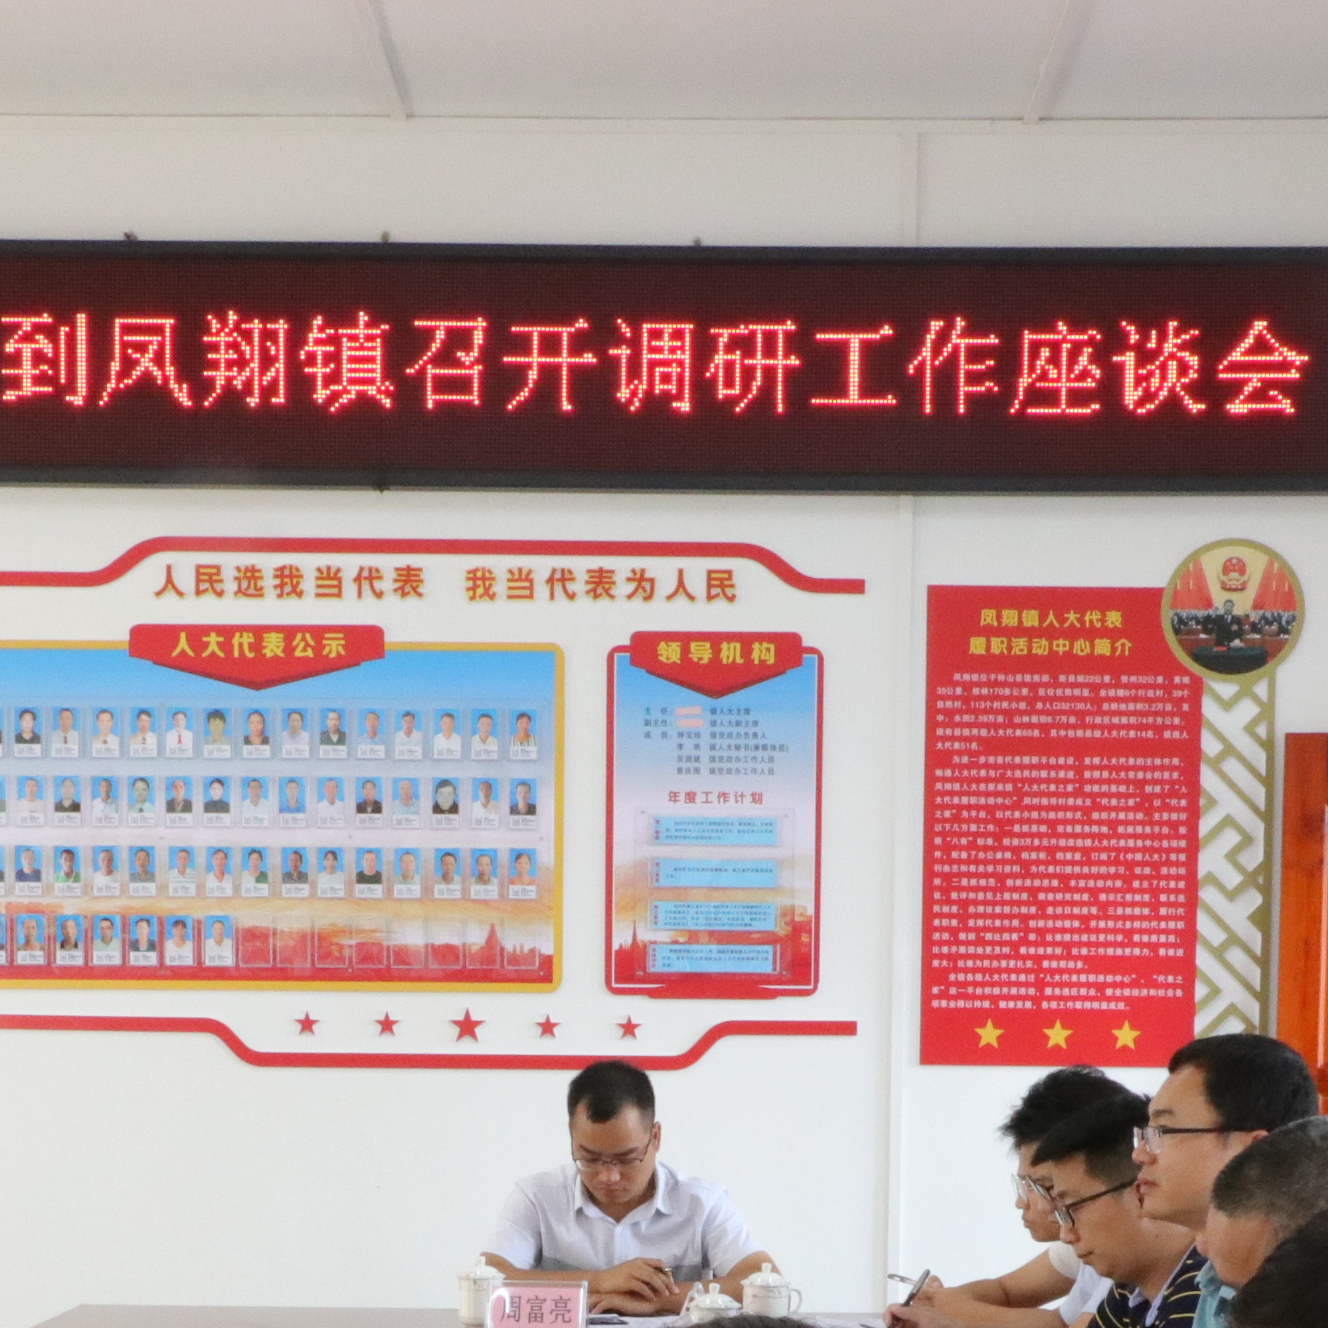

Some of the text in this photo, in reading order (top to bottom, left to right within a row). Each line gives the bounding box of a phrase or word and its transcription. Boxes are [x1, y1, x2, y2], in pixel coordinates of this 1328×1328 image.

[155, 565, 738, 604] 人民选我当代表 我当代表为人民
[979, 609, 1123, 629] 凤翔镇人大代表
[171, 631, 347, 659] 人大代表公示
[657, 641, 776, 665] 领导机构
[969, 636, 1133, 657] 履职活动中心简介
[667, 790, 764, 805] 年度工作计划
[500, 1295, 571, 1324] 周富亮
